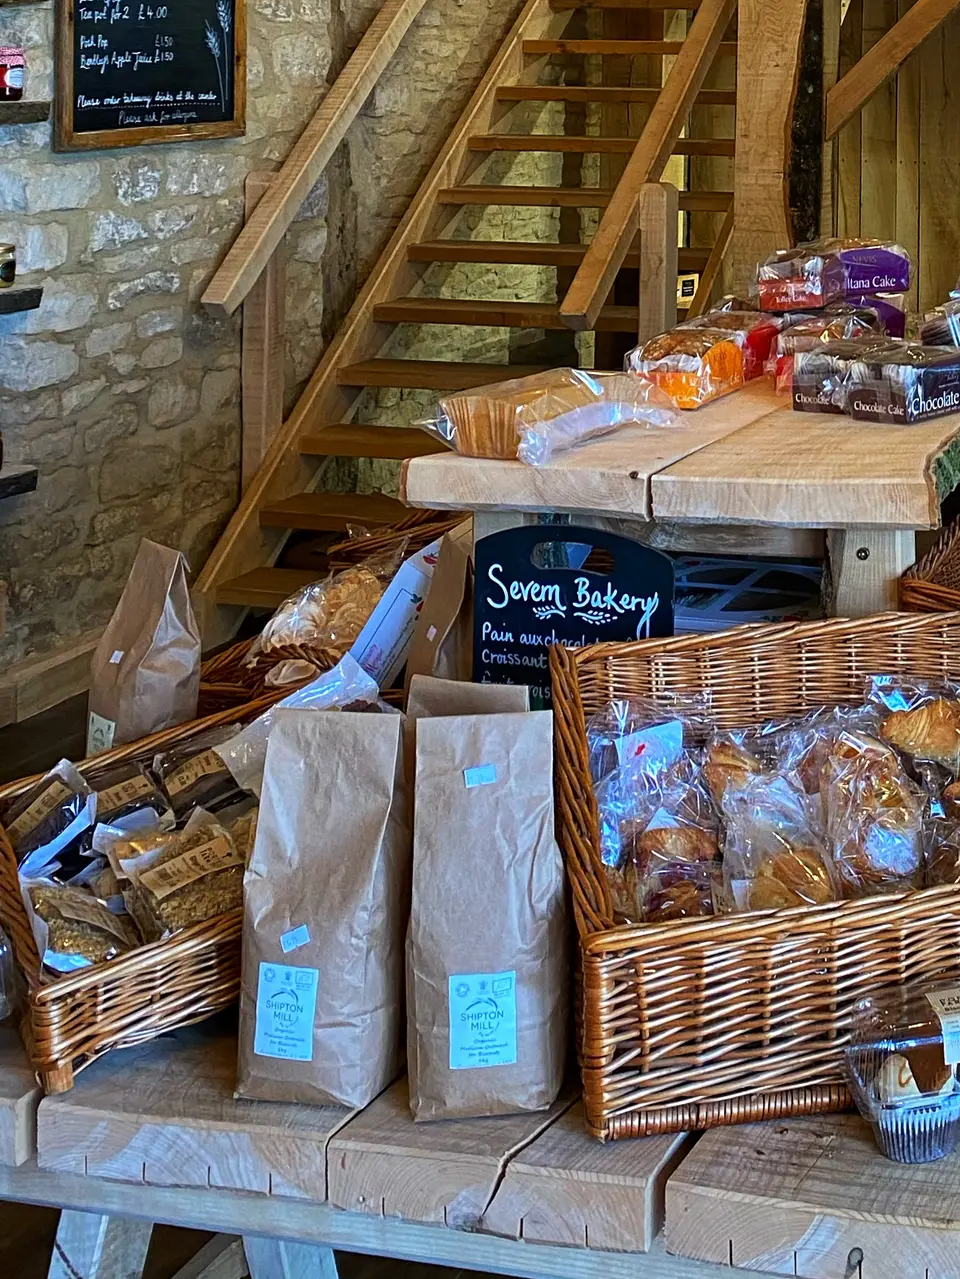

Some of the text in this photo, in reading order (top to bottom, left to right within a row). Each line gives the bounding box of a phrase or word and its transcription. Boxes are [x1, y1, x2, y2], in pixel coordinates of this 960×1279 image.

[121, 5, 130, 19] 2
[77, 94, 101, 109] Please
[871, 274, 897, 288] Cake
[795, 393, 831, 405] Chocolate
[911, 390, 960, 415] Chocolate
[853, 400, 887, 414] Chocolate
[887, 403, 905, 416] Cake
[572, 576, 659, 641] Bakery
[481, 621, 515, 643] Pain
[481, 648, 548, 669] Croissant
[265, 1000, 304, 1013] SHIPTON
[273, 1011, 294, 1022] MILL
[460, 1010, 504, 1022] SHIPTON
[470, 1021, 494, 1031] MILL
